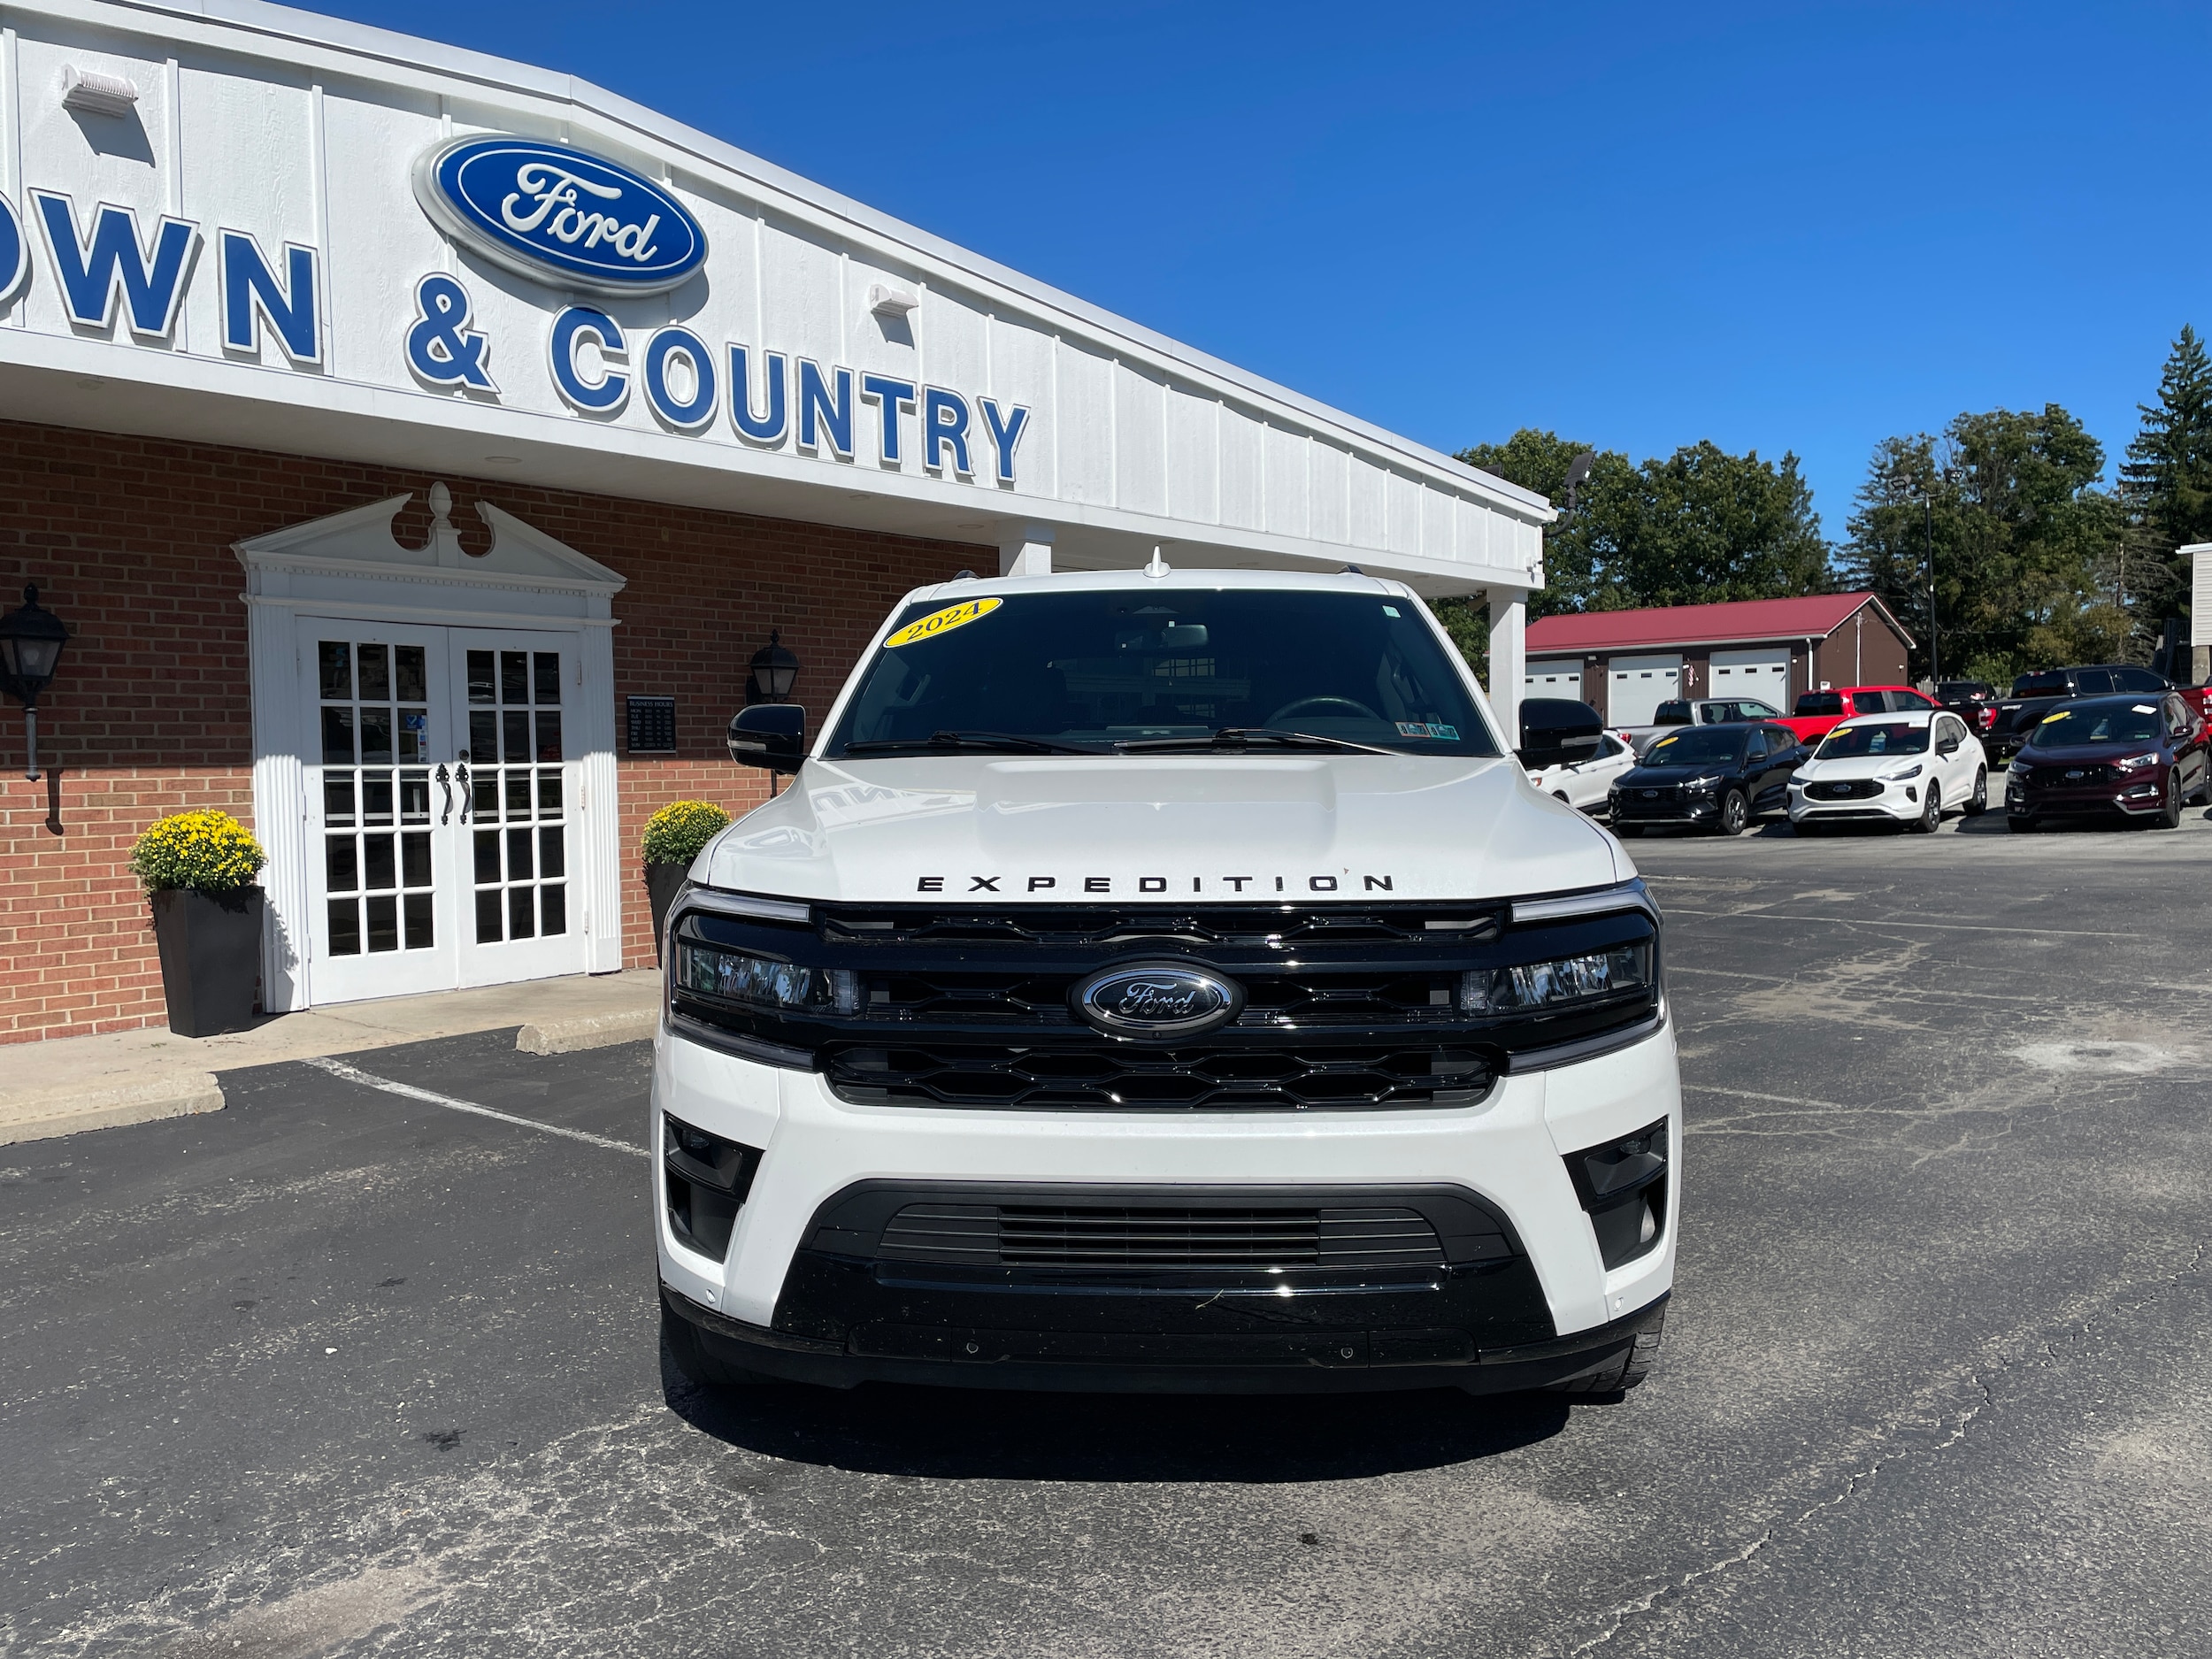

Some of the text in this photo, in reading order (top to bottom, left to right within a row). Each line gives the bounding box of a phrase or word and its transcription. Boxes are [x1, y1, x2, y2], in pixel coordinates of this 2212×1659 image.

[501, 163, 663, 262] Ford
[0, 187, 1031, 483] WN & COUNTRY
[906, 602, 984, 641] 2024
[917, 874, 1394, 894] EXPEDITION
[1118, 982, 1196, 1015] Ford
